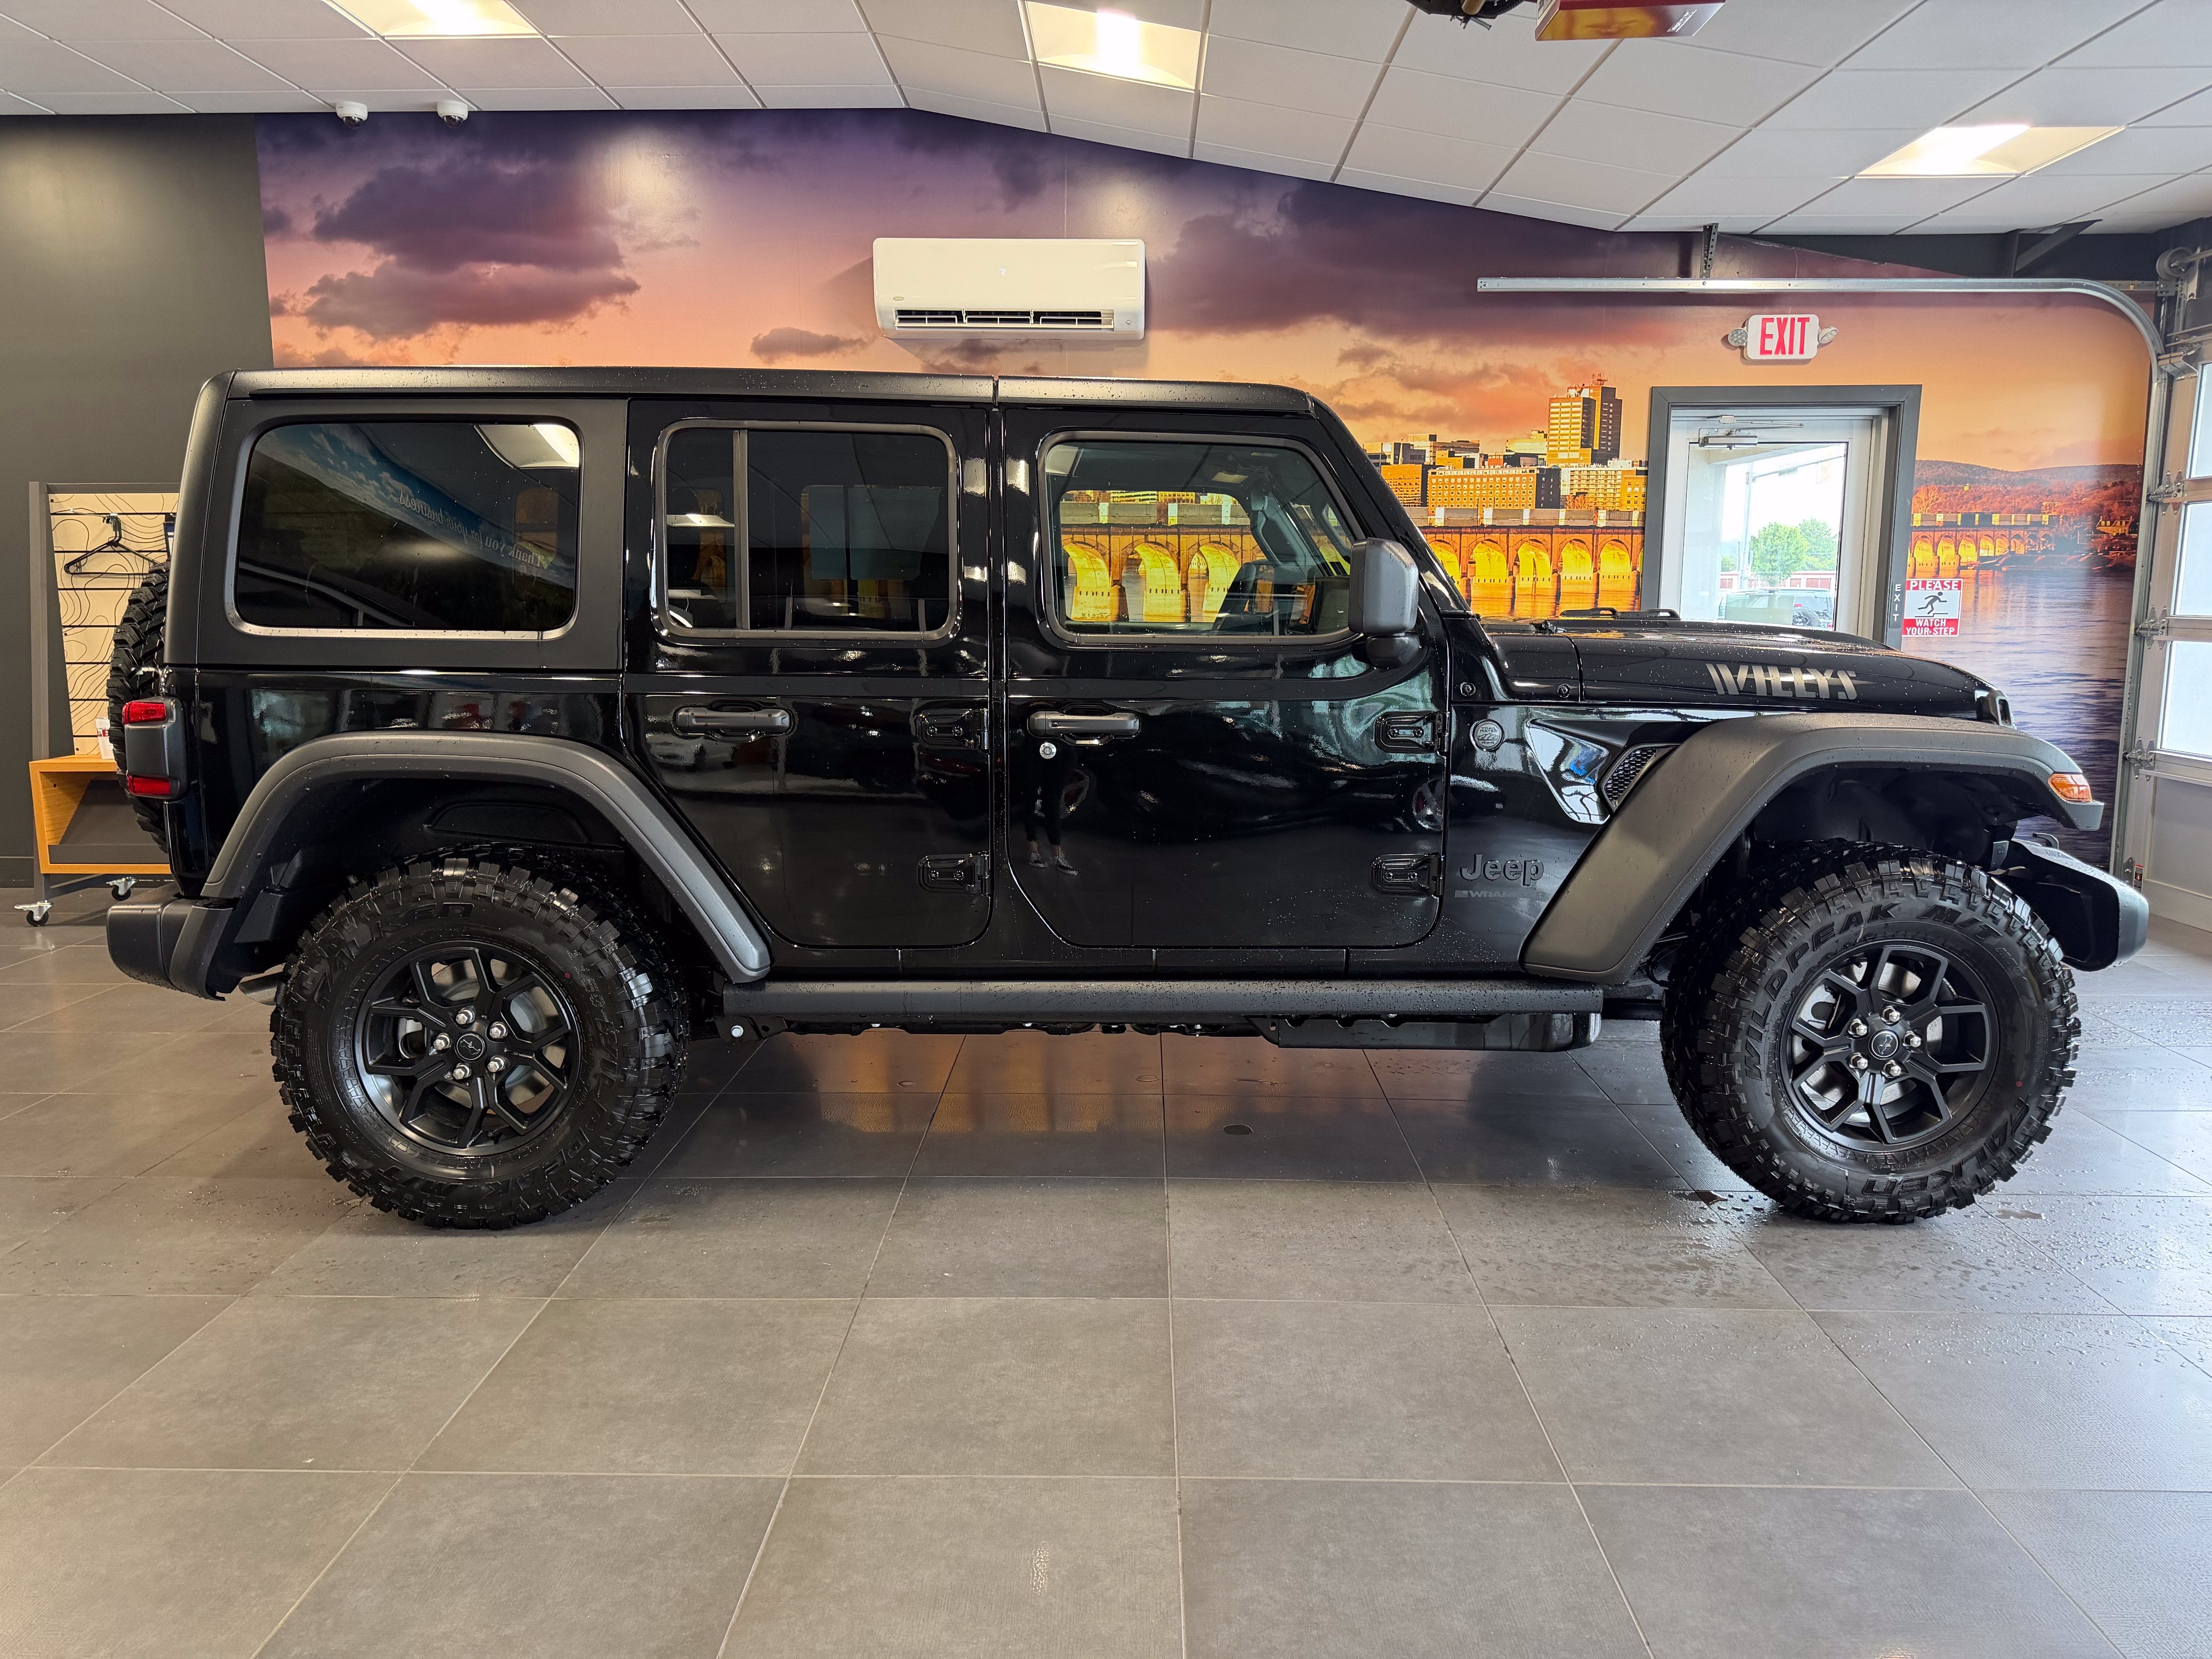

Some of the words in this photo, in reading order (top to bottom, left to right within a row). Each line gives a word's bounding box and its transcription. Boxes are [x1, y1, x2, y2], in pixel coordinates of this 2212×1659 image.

[1760, 317, 1810, 355] EXIT
[1893, 584, 1901, 622] EXIT
[1910, 580, 1958, 590] PLEASE
[1906, 627, 1930, 635] YOUR
[1933, 627, 1955, 635] STEP
[1705, 663, 1857, 700] WILLYS
[1460, 854, 1544, 886] Jeep
[1745, 903, 1900, 1080] WILDPEAK
[1917, 904, 2003, 941] M/T
[1862, 1094, 2030, 1195] FALKEN
